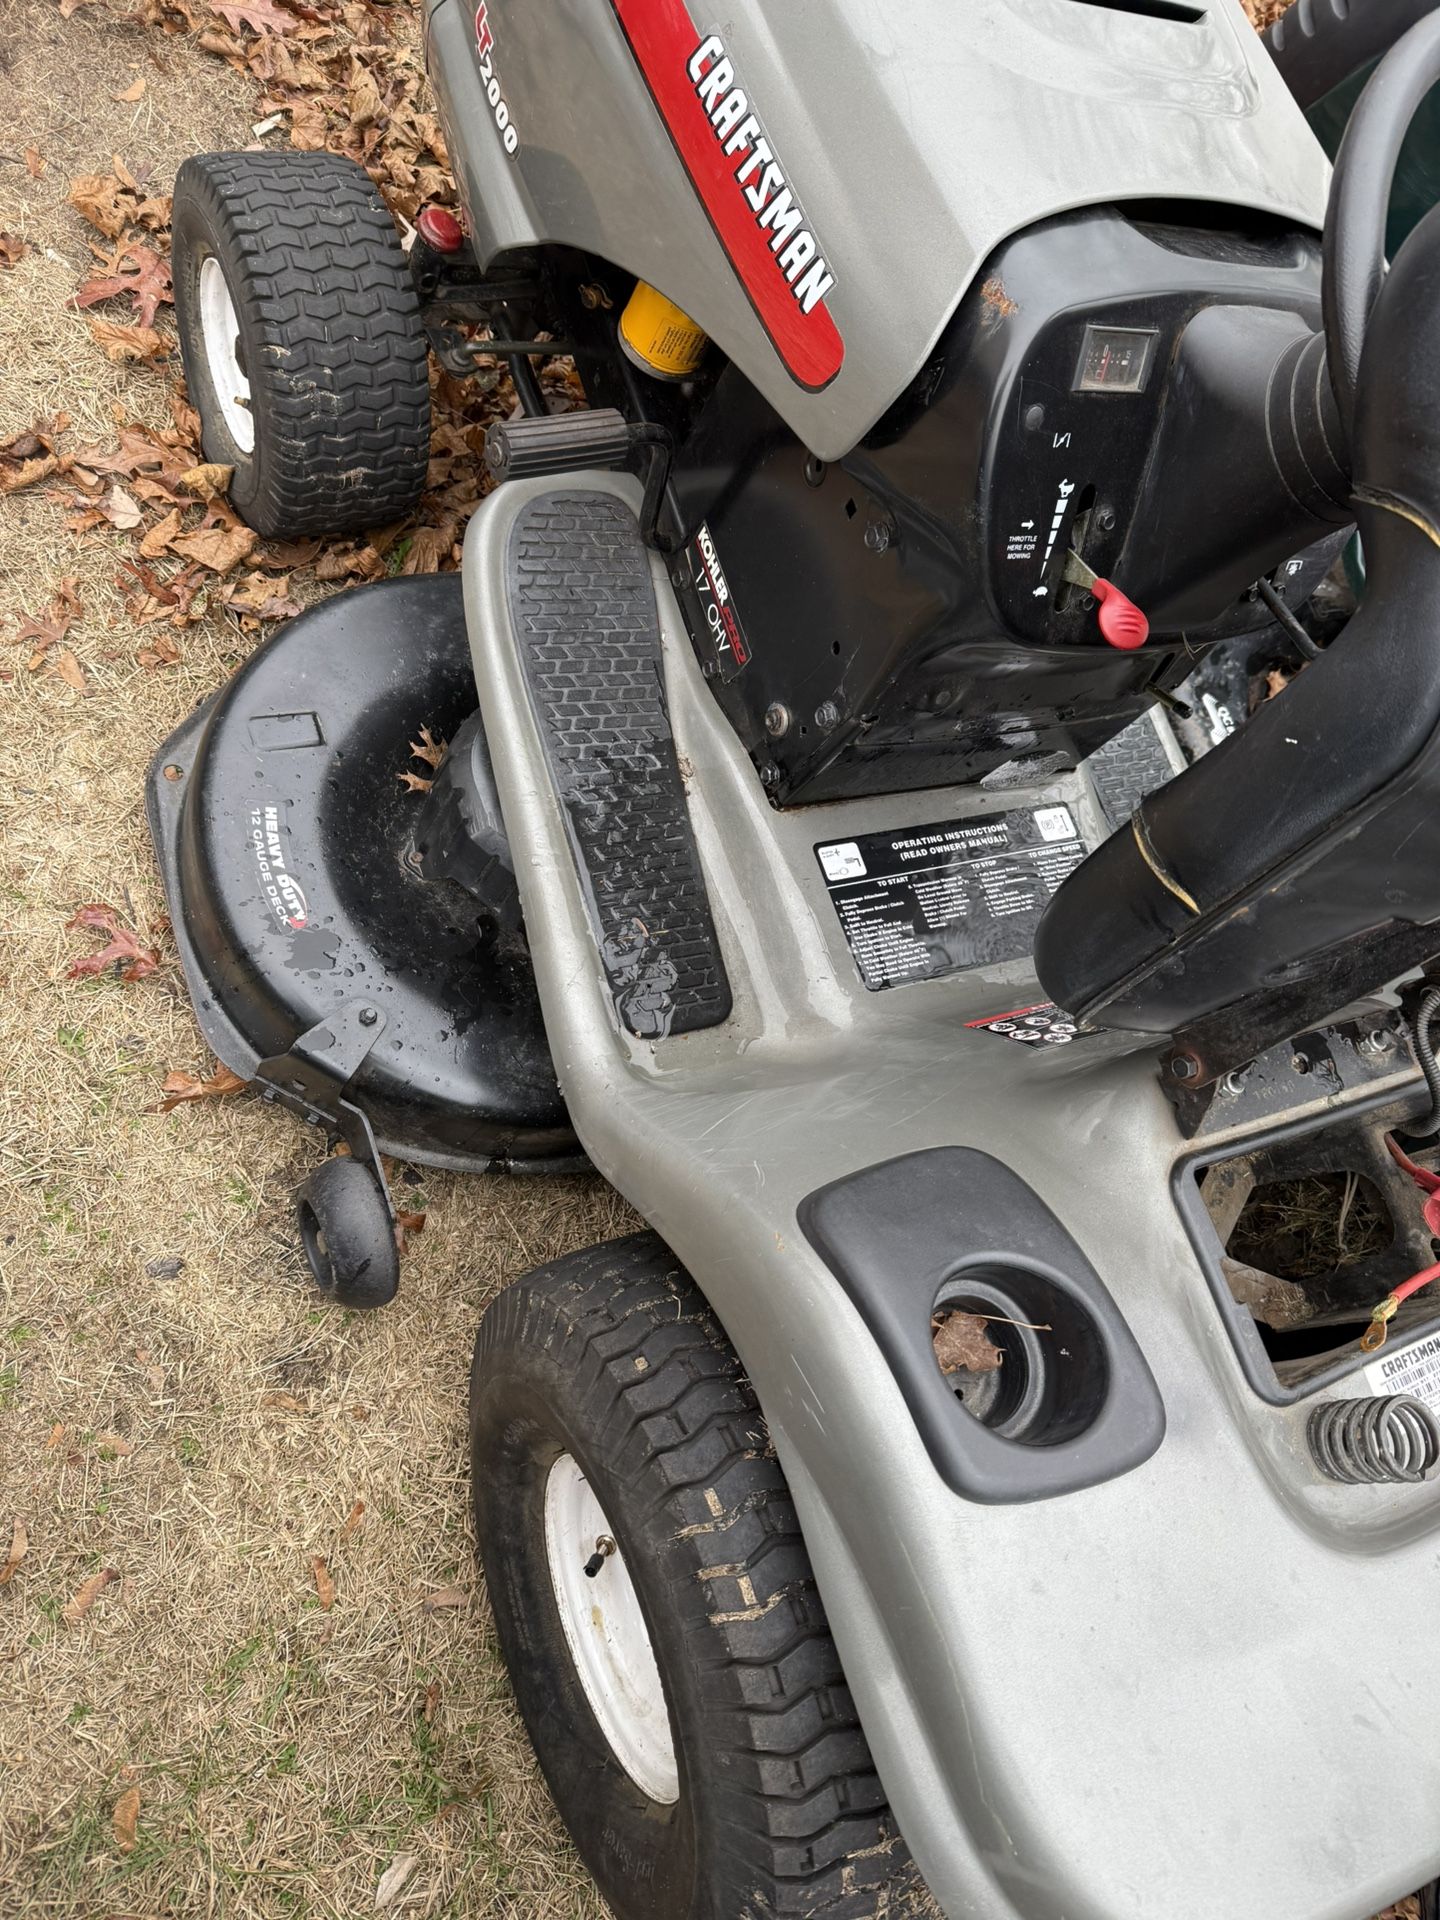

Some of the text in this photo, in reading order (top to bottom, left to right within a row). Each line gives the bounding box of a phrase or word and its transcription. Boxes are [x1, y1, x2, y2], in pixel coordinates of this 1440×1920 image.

[688, 35, 836, 314] CRAFTSMAN
[697, 526, 728, 606] KOHLER
[696, 568, 730, 652] 17 OHV
[250, 808, 290, 926] 12 GAUGE DECK
[265, 806, 306, 920] HEAVY DUTY
[891, 823, 1009, 850] OPERATING INSTRUCTIONS
[900, 834, 1008, 862] (READ OWNERS MANUAL)
[887, 876, 908, 885] START
[1381, 1336, 1440, 1378] CRAFTSMAN
